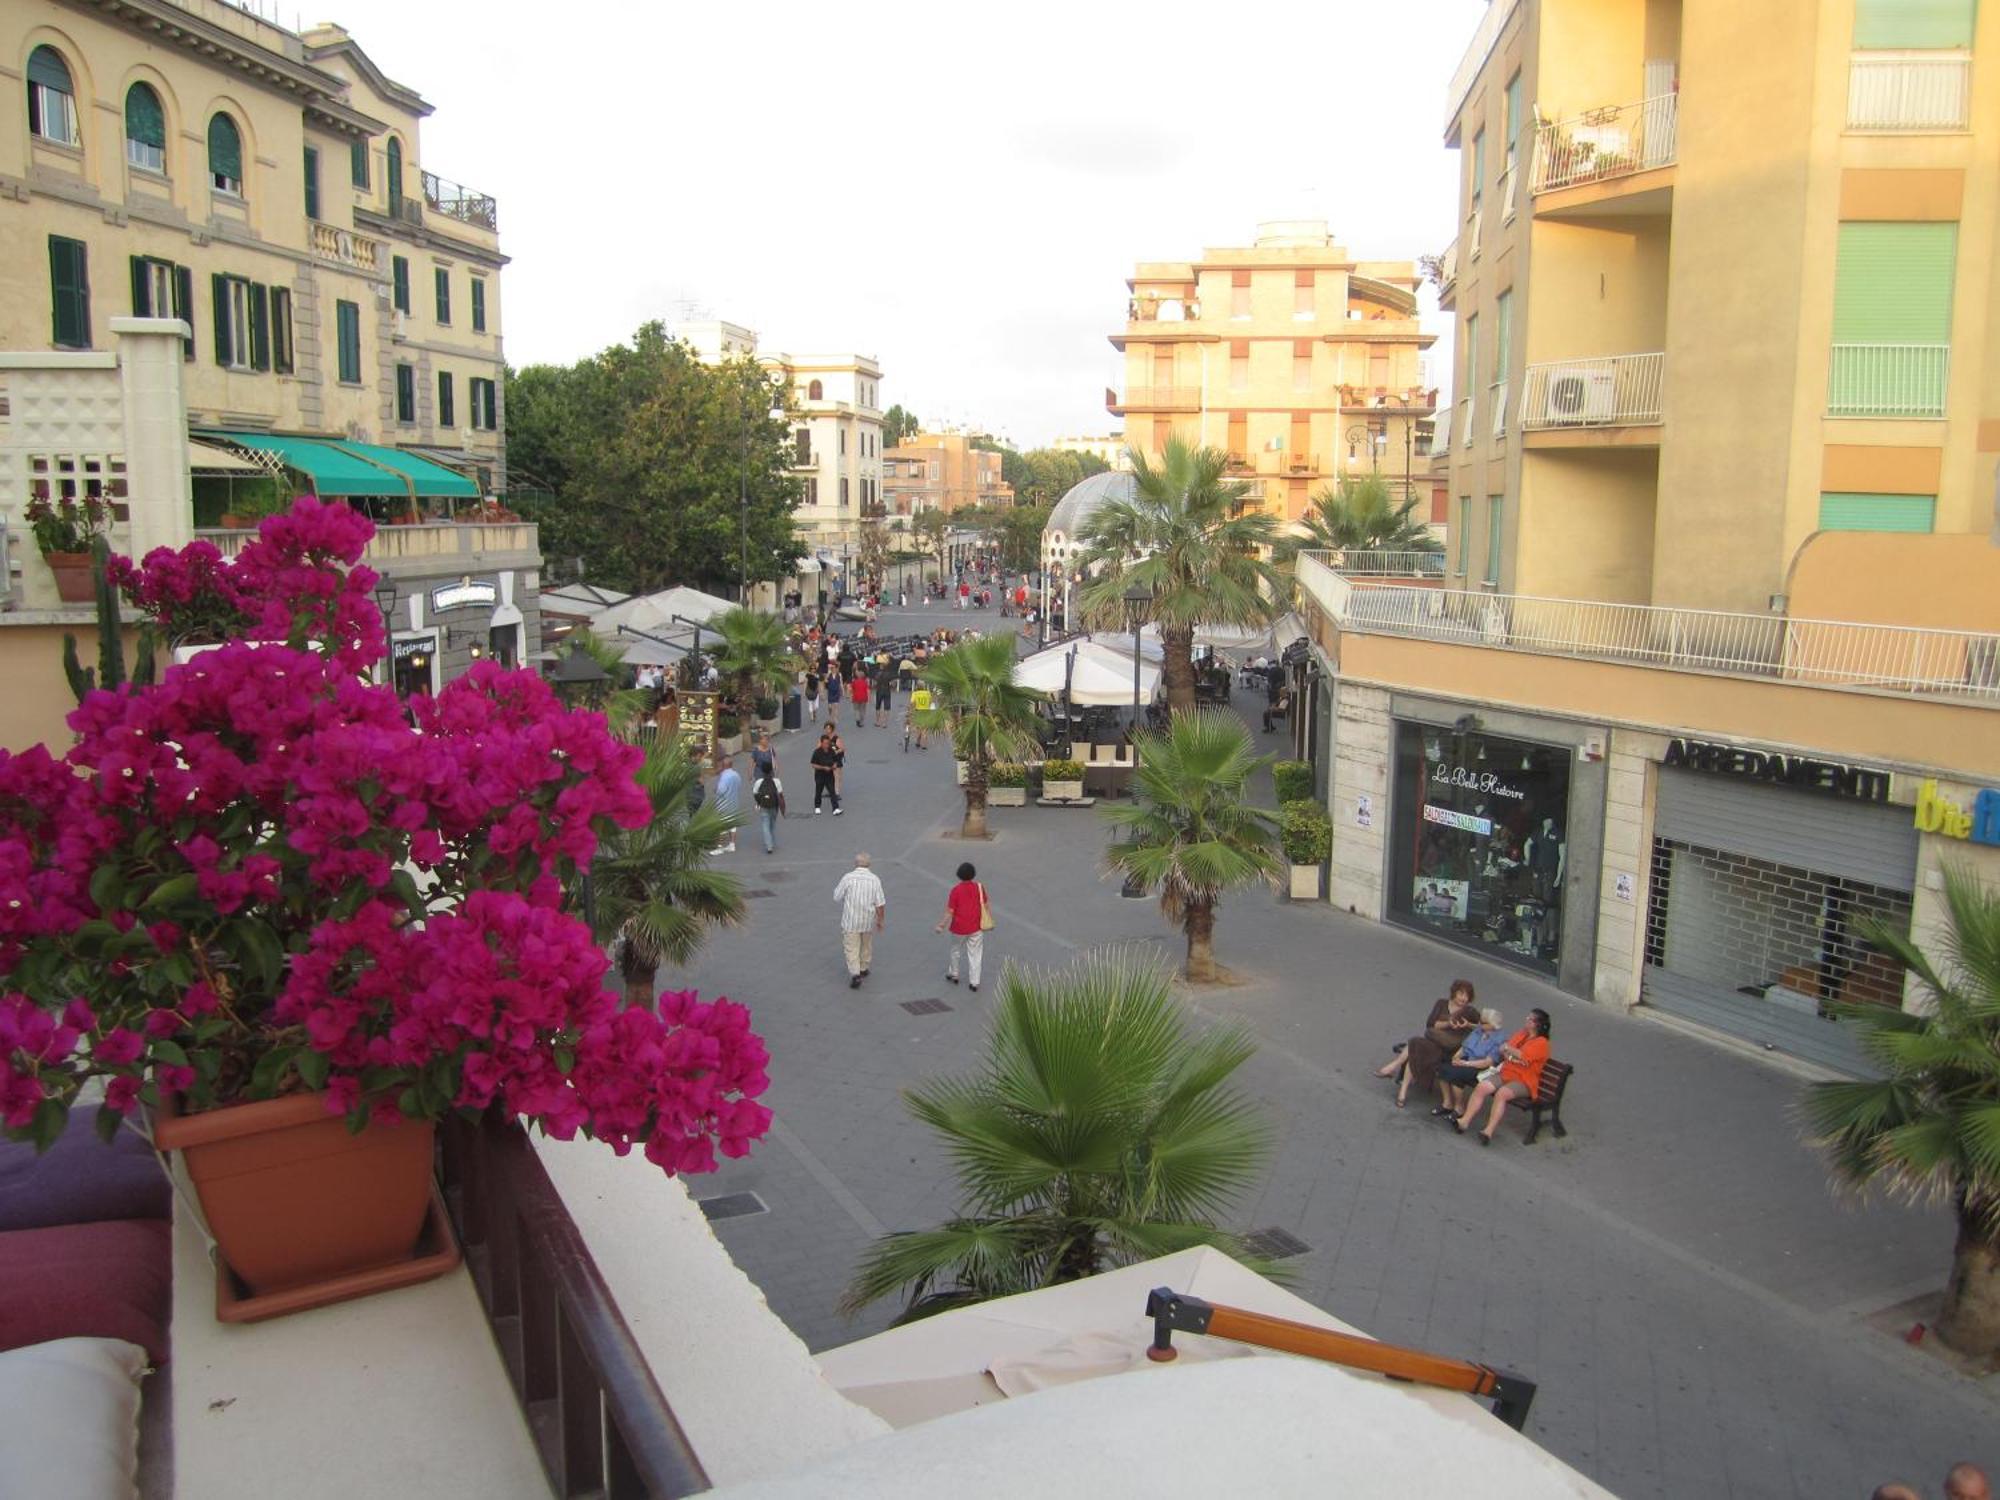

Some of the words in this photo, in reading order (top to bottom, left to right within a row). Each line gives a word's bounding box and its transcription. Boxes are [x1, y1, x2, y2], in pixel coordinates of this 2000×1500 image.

[1432, 763, 1449, 784] La
[1450, 767, 1479, 790] Belle
[1480, 773, 1525, 800] Histoire
[1663, 738, 1894, 802] ARREDAMENTI
